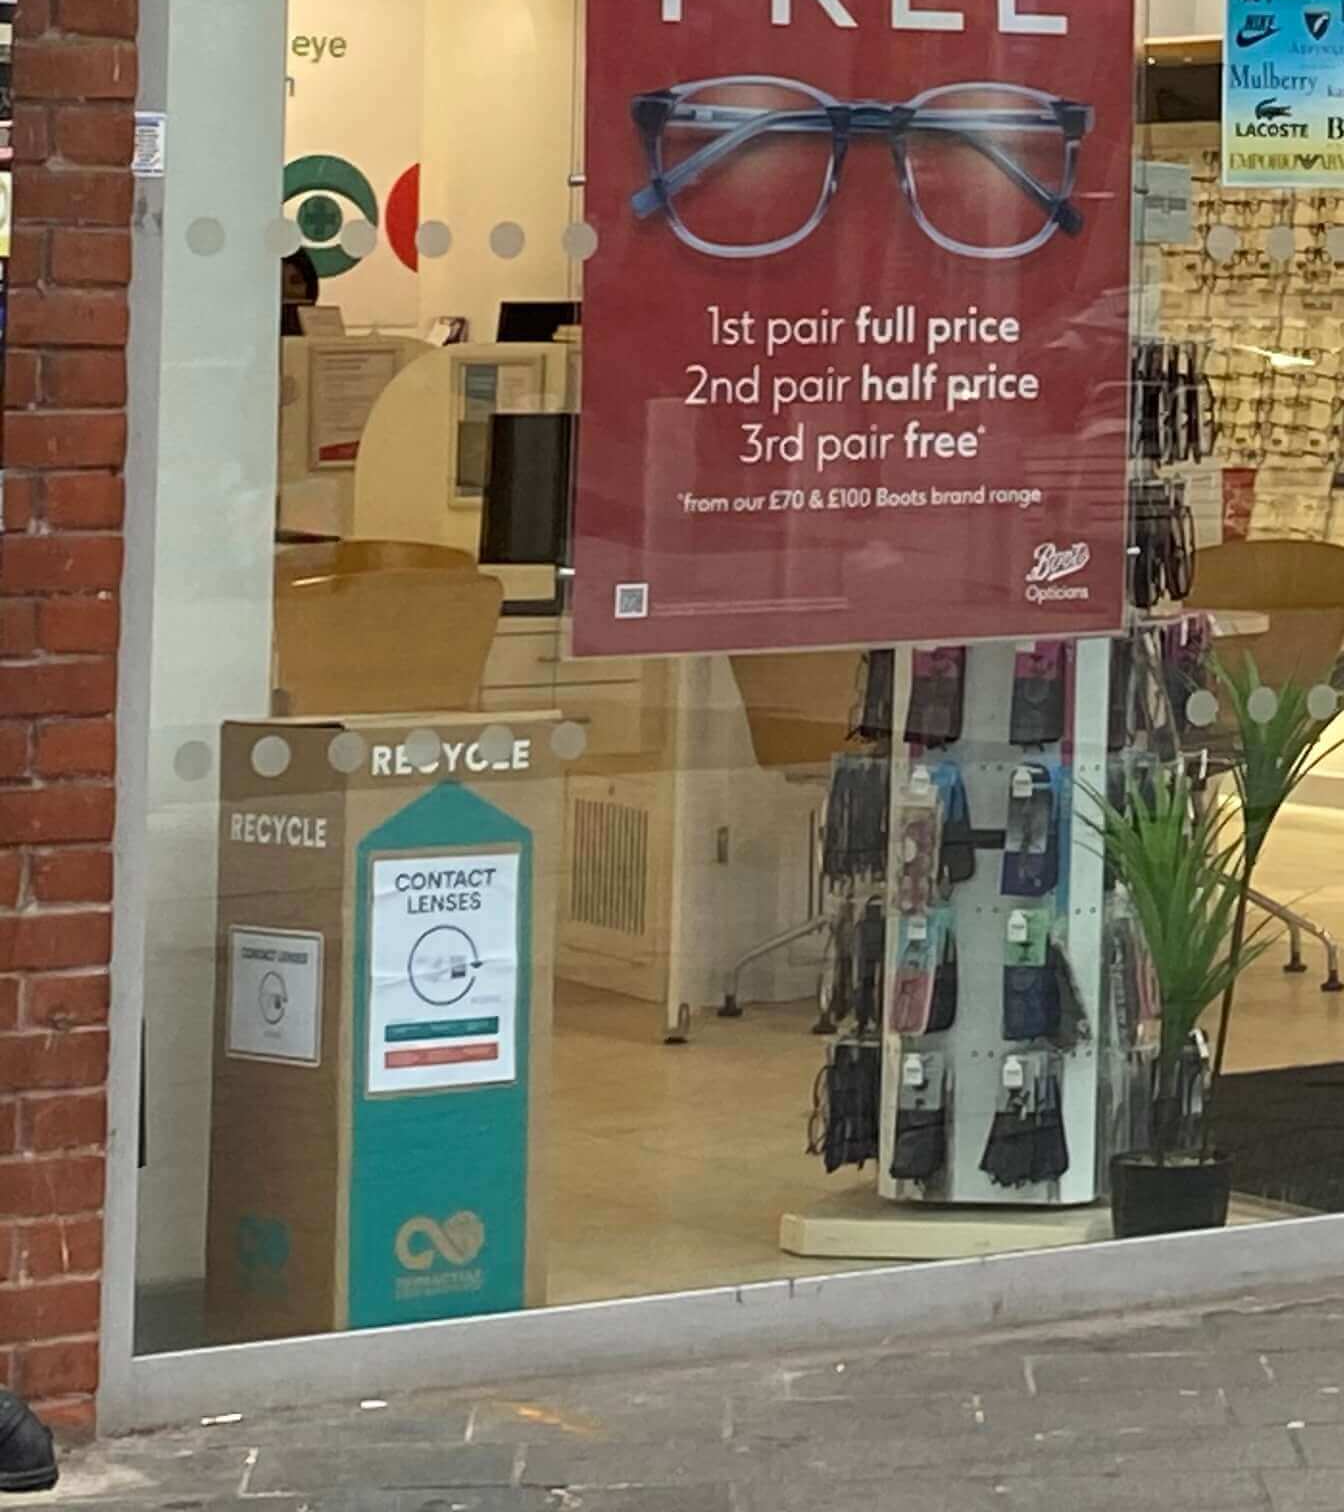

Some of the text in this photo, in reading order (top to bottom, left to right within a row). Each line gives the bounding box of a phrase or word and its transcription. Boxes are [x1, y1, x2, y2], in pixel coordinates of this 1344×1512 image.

[291, 34, 347, 64] eye
[1230, 61, 1318, 97] Mulberry
[1235, 121, 1310, 138] LACOSTE
[708, 305, 1021, 357] 1st pair full price
[684, 363, 1040, 415] 2nd pair half price
[739, 422, 804, 464] 3rd
[817, 424, 894, 472] pair
[733, 496, 764, 512] our
[768, 490, 805, 511] £70
[810, 490, 823, 510] &
[827, 488, 870, 509] £100
[875, 487, 928, 508] Boots
[931, 486, 986, 506] brand
[989, 488, 1043, 509] range
[231, 813, 327, 848] RECYCLE
[395, 867, 497, 892] CONTACT
[407, 893, 482, 915] LENSES
